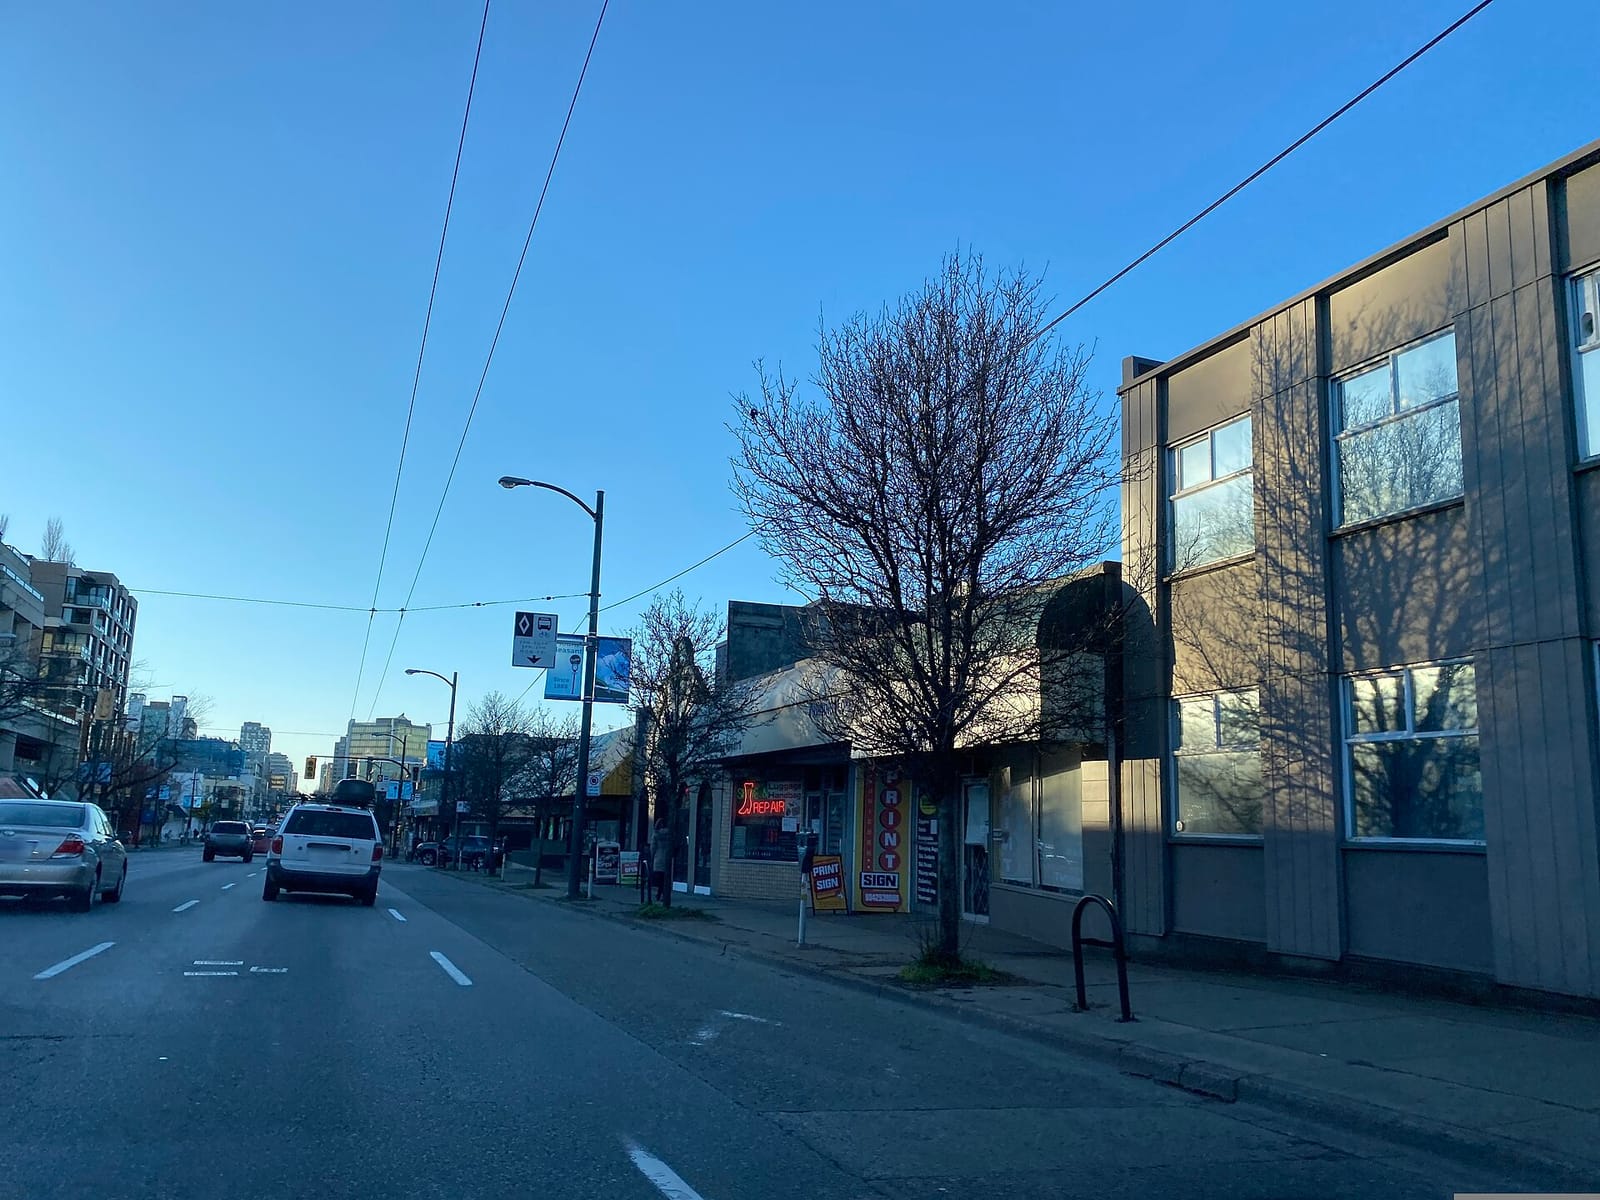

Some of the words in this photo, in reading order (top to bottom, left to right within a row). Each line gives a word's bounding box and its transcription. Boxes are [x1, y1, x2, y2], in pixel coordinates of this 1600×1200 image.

[753, 800, 786, 814] REPAIR
[812, 863, 839, 877] PRINT
[816, 876, 839, 890] SIGN
[863, 874, 897, 887] SIGN
